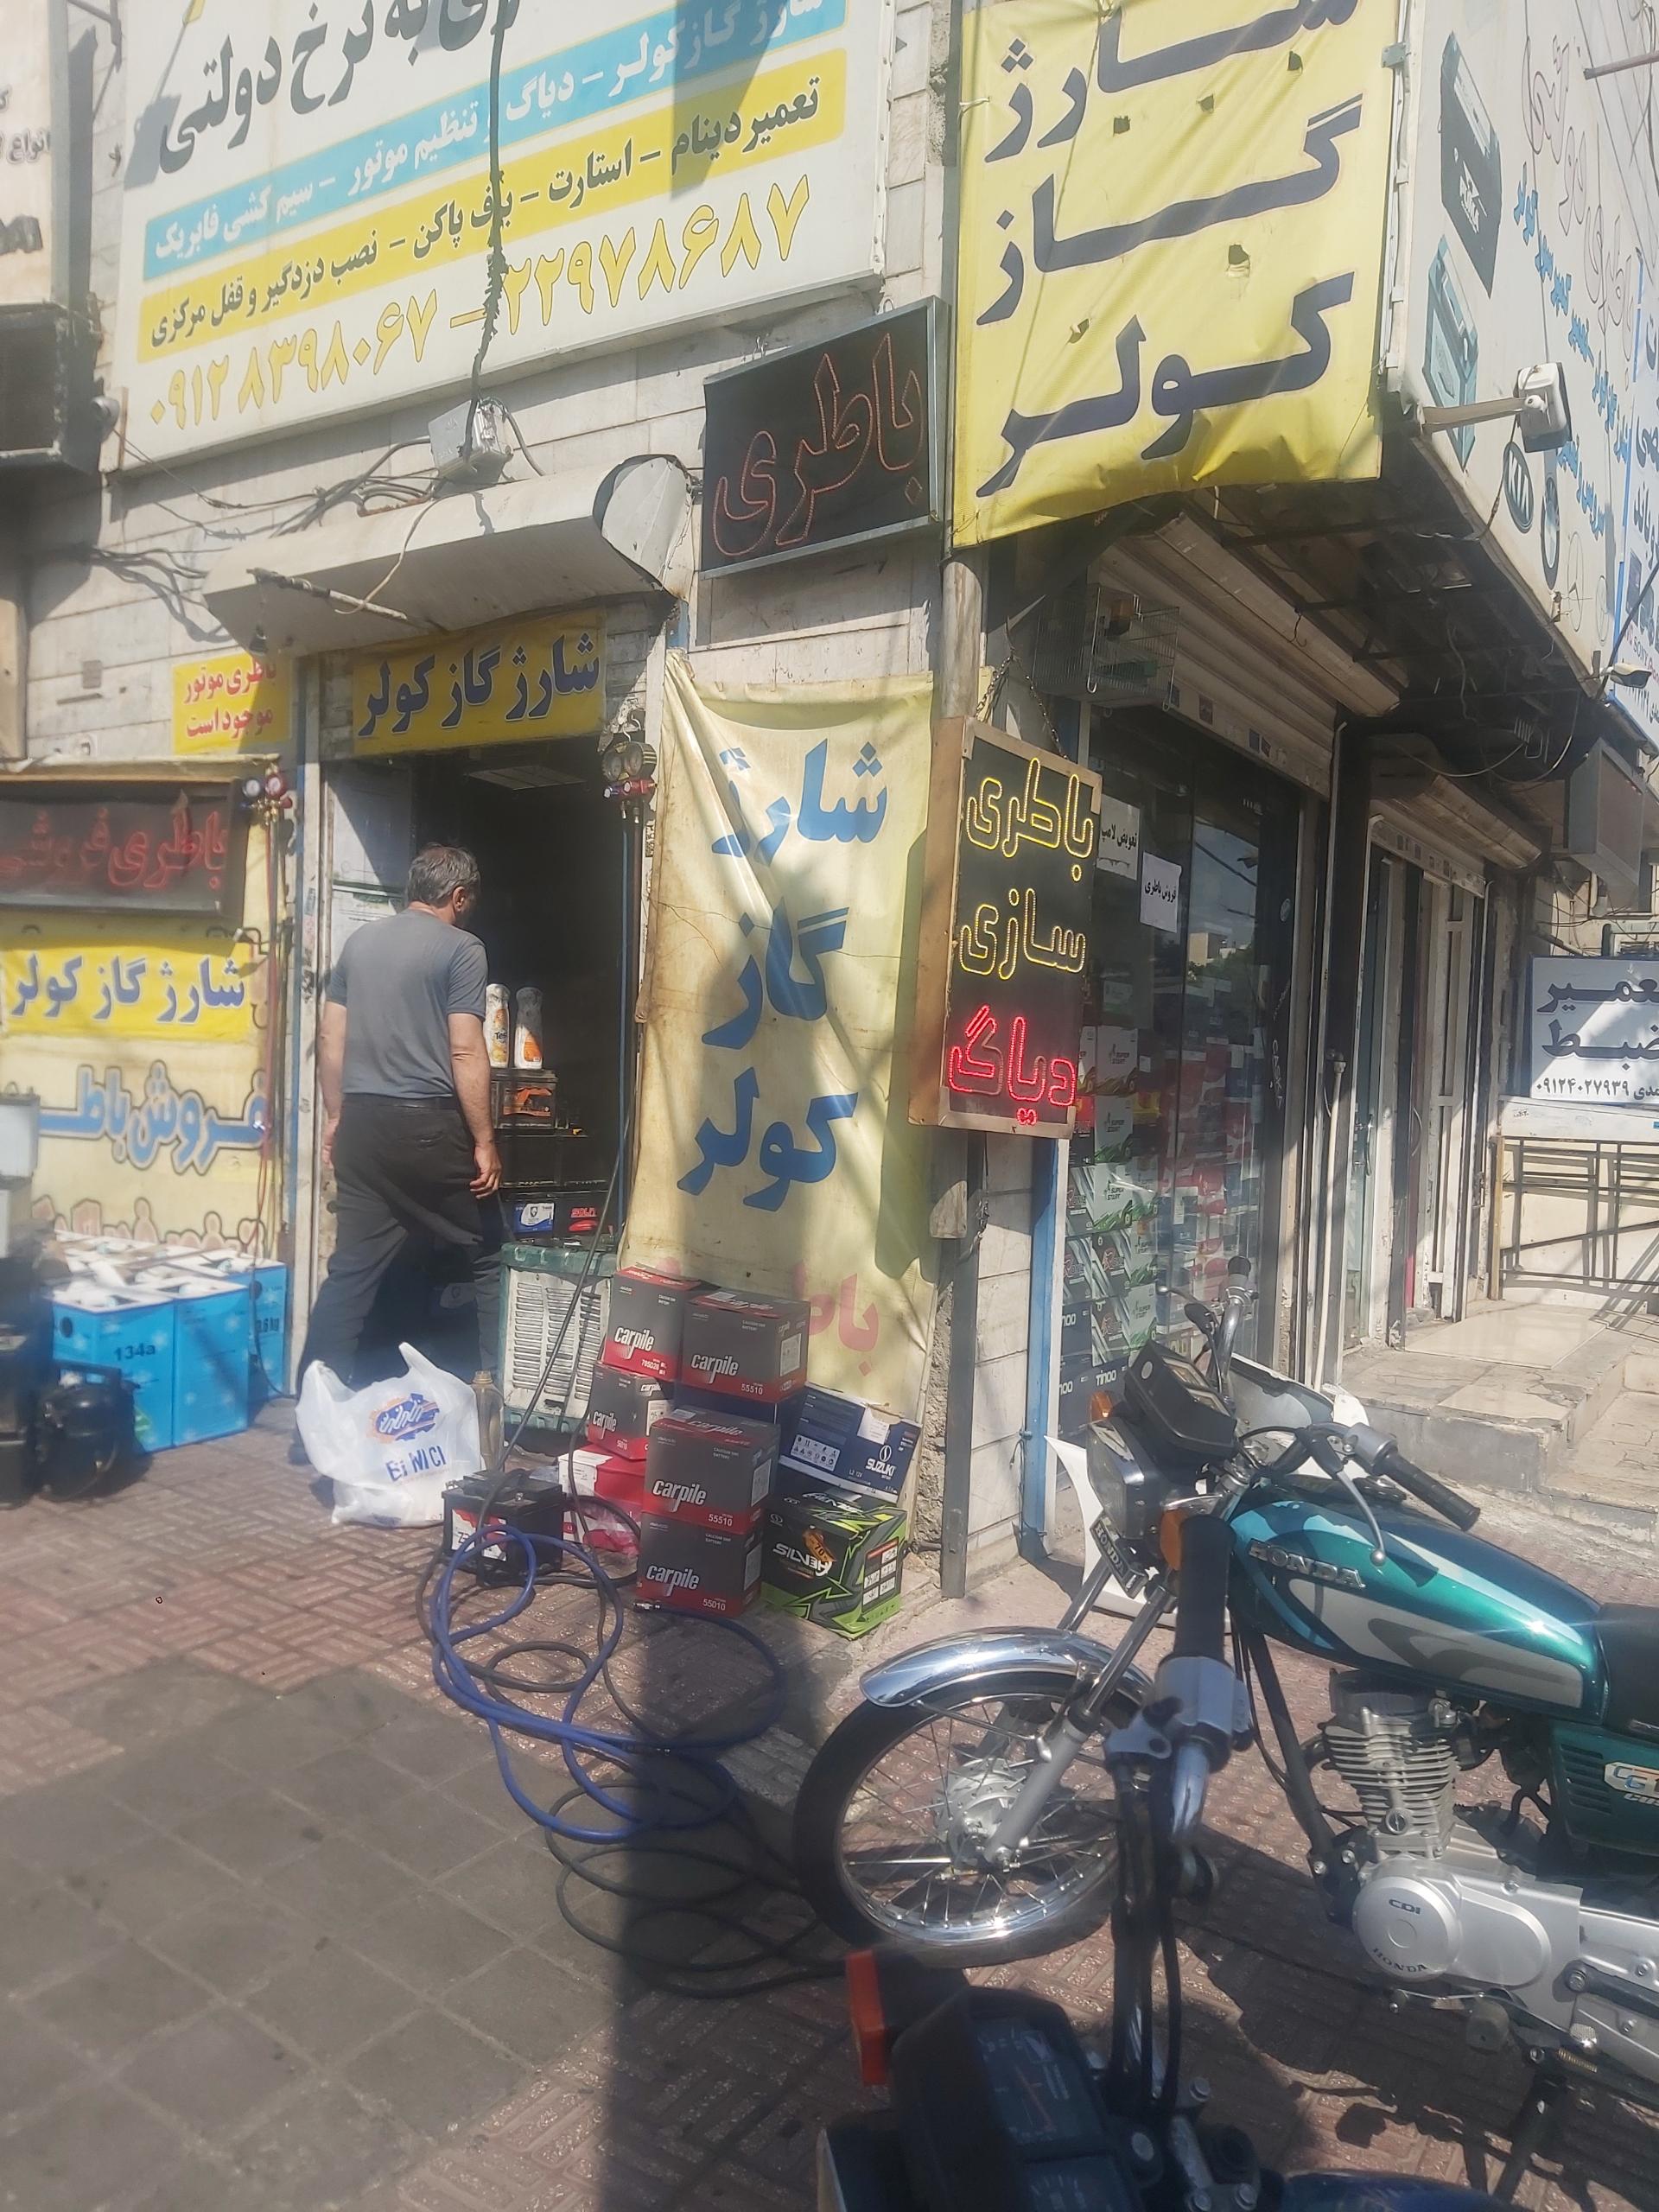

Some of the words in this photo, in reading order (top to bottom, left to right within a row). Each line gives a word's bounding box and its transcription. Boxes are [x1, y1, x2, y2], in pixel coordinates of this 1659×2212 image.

[607, 22, 689, 97] کولر
[159, 35, 283, 175] دولتی
[742, 76, 820, 153] تعمیر
[414, 101, 479, 170] تنظیم
[671, 111, 741, 175] دینام
[346, 138, 409, 197] موتور
[548, 138, 632, 209] استارت
[275, 180, 314, 223] سیم
[976, 92, 1364, 327] گاز
[155, 204, 220, 259] فابریک
[330, 230, 378, 286] نصب
[209, 275, 244, 327] قفل
[245, 290, 257, 318] و
[260, 256, 325, 313] دزدگیر
[151, 297, 206, 347] مرکزی
[975, 271, 1355, 498] کولر
[712, 332, 925, 556] باطری
[1507, 449, 1530, 521] KIA
[183, 664, 224, 705] موتور
[358, 653, 436, 736] کولر
[440, 645, 501, 728] گاز
[505, 632, 601, 722] شارژ
[186, 707, 219, 739] است
[222, 705, 273, 740] موجود
[712, 740, 888, 858] شارژ
[966, 757, 1094, 882] باطری
[1144, 880, 1162, 899] باطری
[1161, 885, 1177, 903] فروش
[959, 888, 1086, 981] سازی
[10, 954, 83, 1017] کولر
[93, 957, 146, 1020] گاز
[156, 955, 246, 1024] شارژ
[701, 896, 850, 1049] گاز
[1536, 978, 1659, 1014] عمیر
[949, 1004, 1077, 1126] دیاگ
[677, 1067, 859, 1212] کولر
[113, 1342, 156, 1362] 134a
[613, 1325, 655, 1360] carpile
[691, 1353, 740, 1384] carpile
[741, 1382, 764, 1395] 55510
[592, 1409, 618, 1440] carpile
[652, 1478, 707, 1512] carpile
[865, 1458, 896, 1477] SUZUKI
[708, 1512, 733, 1528] 55510
[1094, 1522, 1125, 1574] HONDA
[1249, 1540, 1367, 1589] HONDA
[645, 1563, 701, 1598] carpile
[702, 1598, 726, 1611] 55010
[1388, 1898, 1421, 1915] CDI
[1371, 1947, 1428, 1974] HONDA
